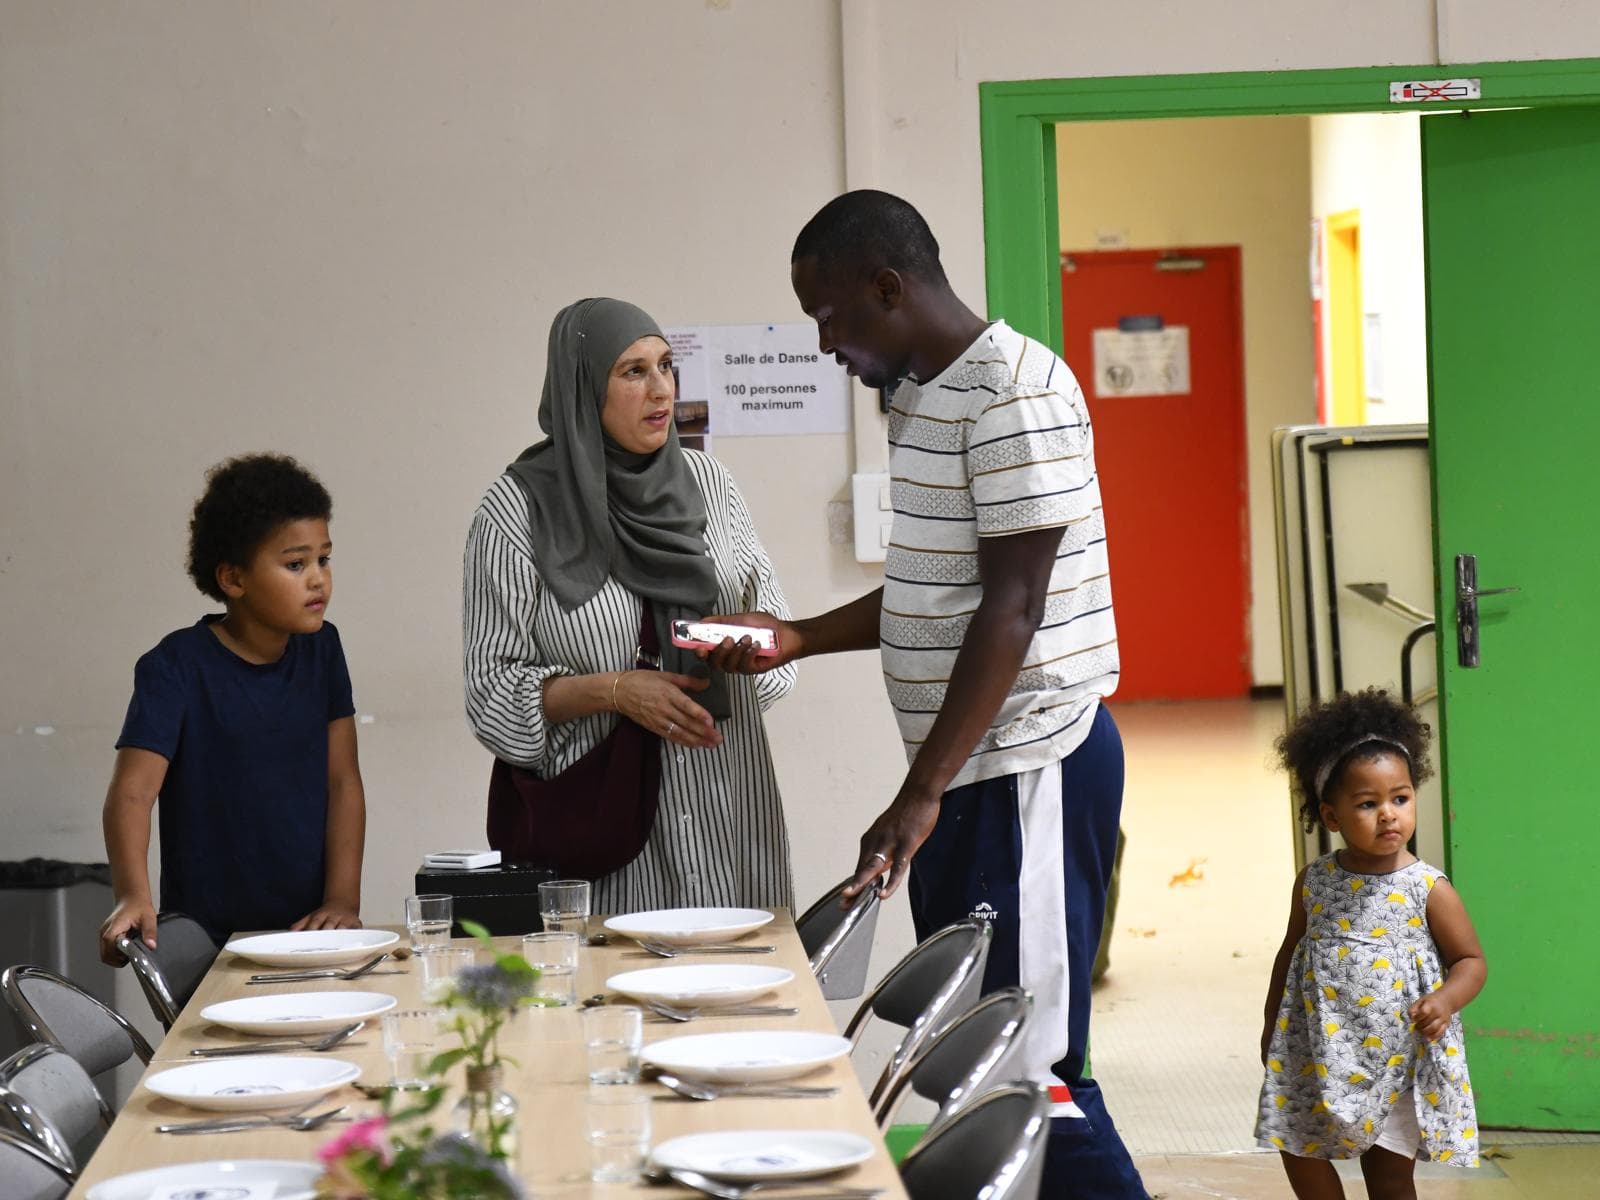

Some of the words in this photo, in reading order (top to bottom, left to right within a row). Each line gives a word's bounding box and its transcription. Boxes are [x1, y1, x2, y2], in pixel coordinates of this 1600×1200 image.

[724, 353, 756, 365] Salle
[759, 353, 775, 364] de
[778, 352, 819, 364] Danse
[724, 384, 747, 396] 100
[750, 384, 818, 397] personnes
[741, 399, 804, 411] maximum
